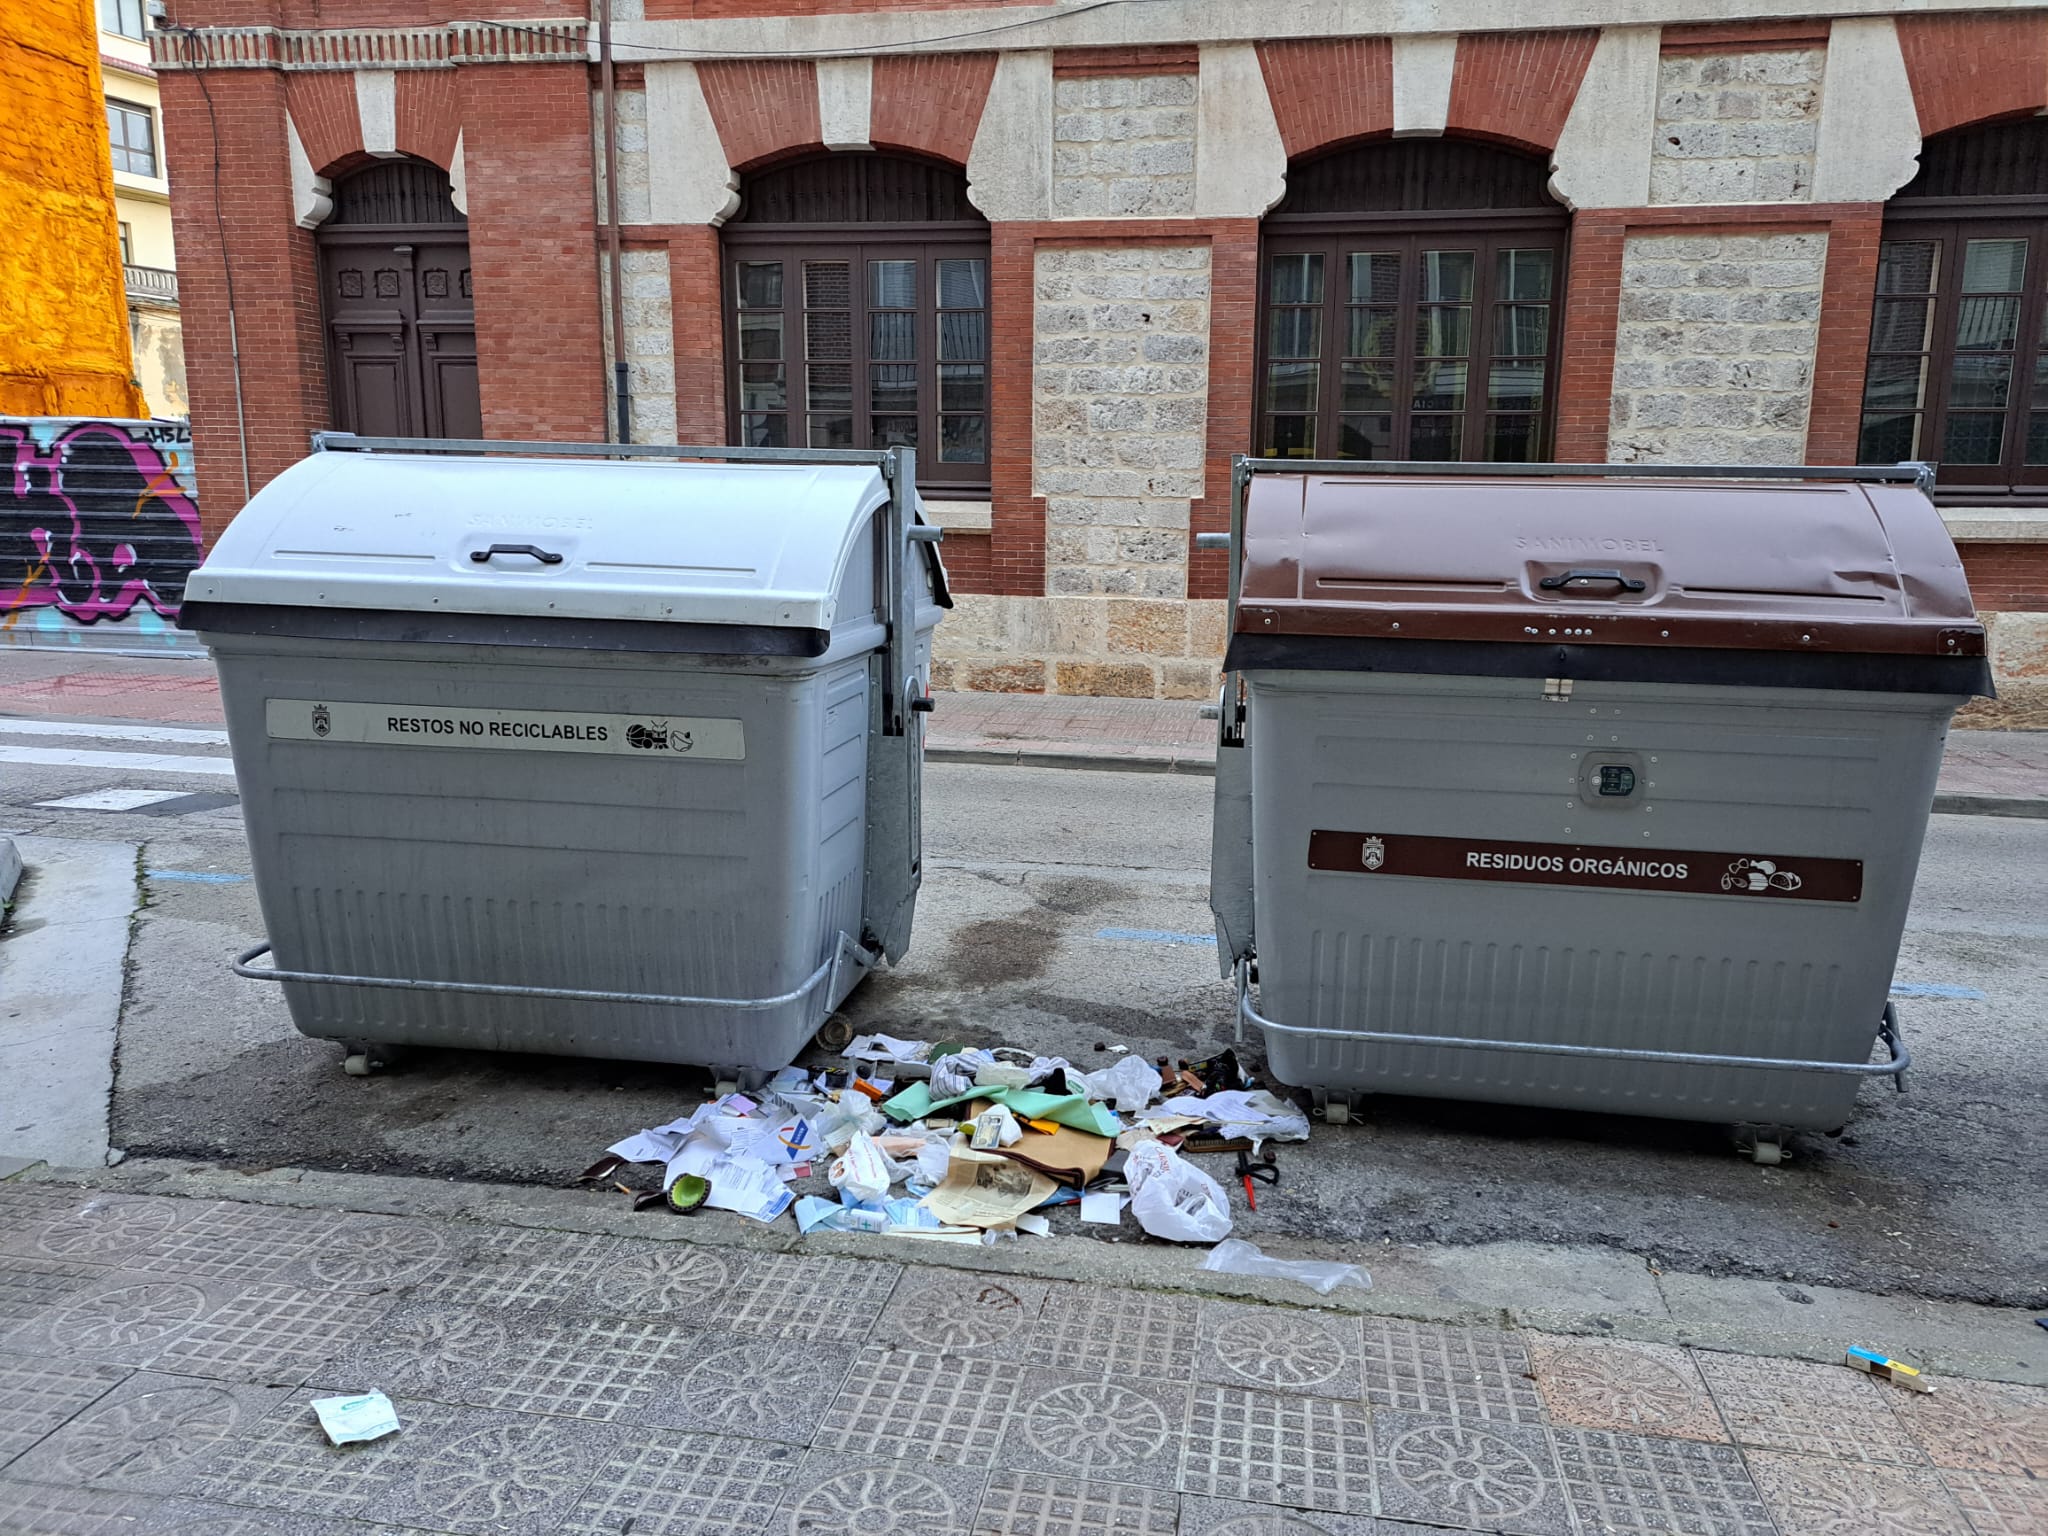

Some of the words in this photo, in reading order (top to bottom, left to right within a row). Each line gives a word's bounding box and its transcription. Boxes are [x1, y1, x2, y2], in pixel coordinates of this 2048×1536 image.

[387, 717, 454, 735] RESTOS
[459, 720, 484, 736] NO
[489, 721, 608, 742] RECICLABLES
[1466, 851, 1564, 873] RESIDUOS
[1569, 856, 1689, 880] ORGÁNICOS
